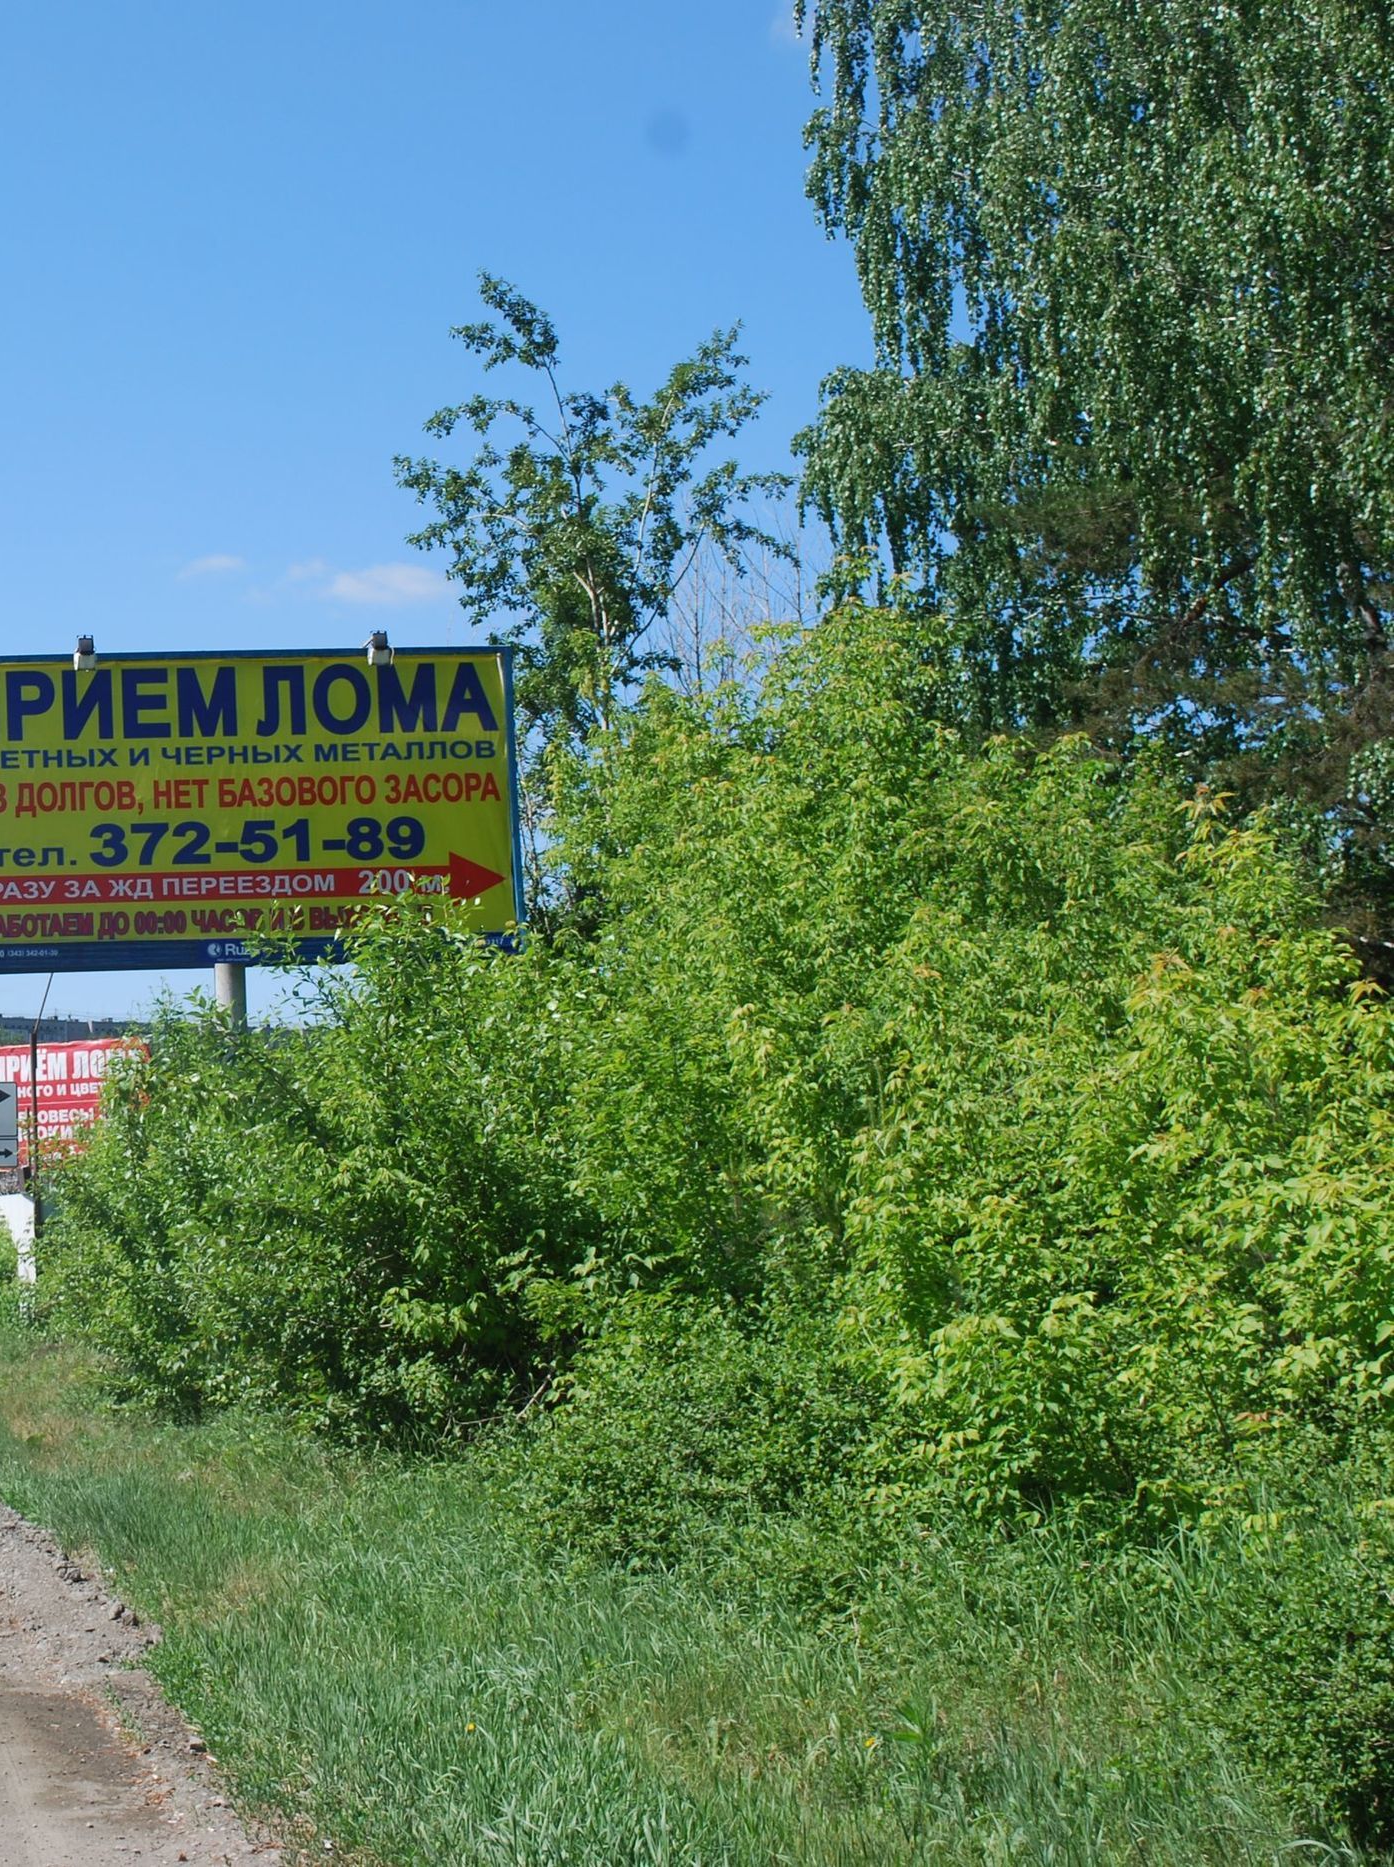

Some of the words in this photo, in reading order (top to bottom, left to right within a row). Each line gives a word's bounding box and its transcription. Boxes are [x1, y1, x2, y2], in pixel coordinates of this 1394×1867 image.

[256, 662, 499, 737] ЛОМА
[129, 747, 150, 766] И
[161, 743, 304, 766] ЧЕРНЫХ
[314, 740, 495, 762] МЕТАЛЛОВ
[15, 780, 144, 818] ДОЛГОВ,
[154, 779, 209, 809] НЕТ
[219, 775, 376, 808] БАЗОВОГО
[384, 772, 501, 804] ЗАСОРА
[89, 816, 426, 867] 372-51-89
[64, 879, 101, 898] ЗА
[109, 877, 154, 899] ЖД
[162, 874, 335, 896] ПЕРЕЕЗДОМ
[358, 869, 411, 894] 200
[97, 910, 131, 939] ДО
[134, 910, 187, 935] 00:00
[56, 1085, 66, 1096] И
